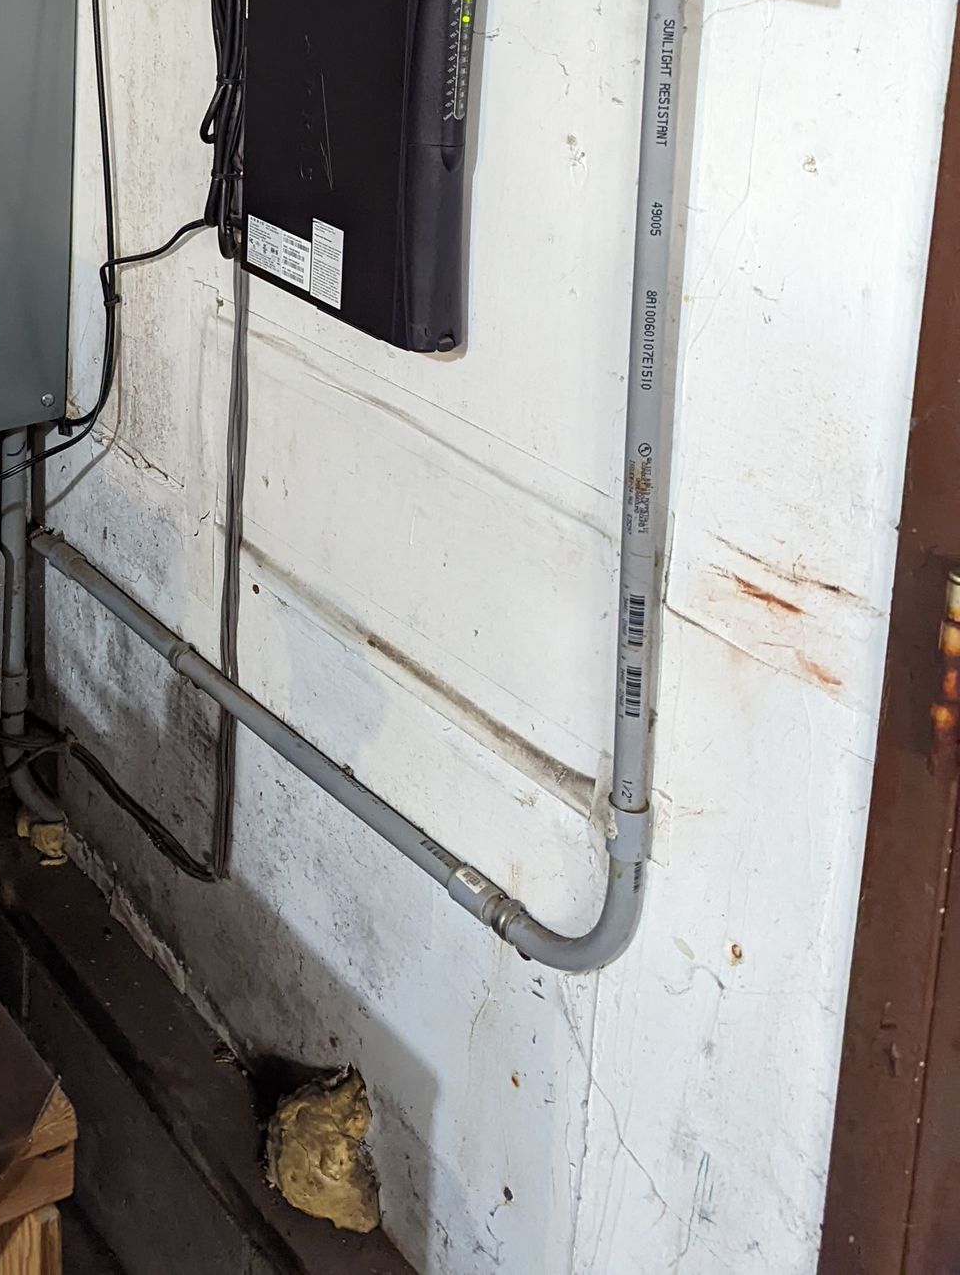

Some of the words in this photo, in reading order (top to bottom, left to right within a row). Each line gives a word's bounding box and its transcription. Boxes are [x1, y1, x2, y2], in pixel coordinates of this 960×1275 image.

[661, 18, 676, 77] SUNLIGHT
[656, 82, 671, 147] RESISTANT
[649, 201, 663, 237] 49005
[621, 779, 633, 804] 1/2"
